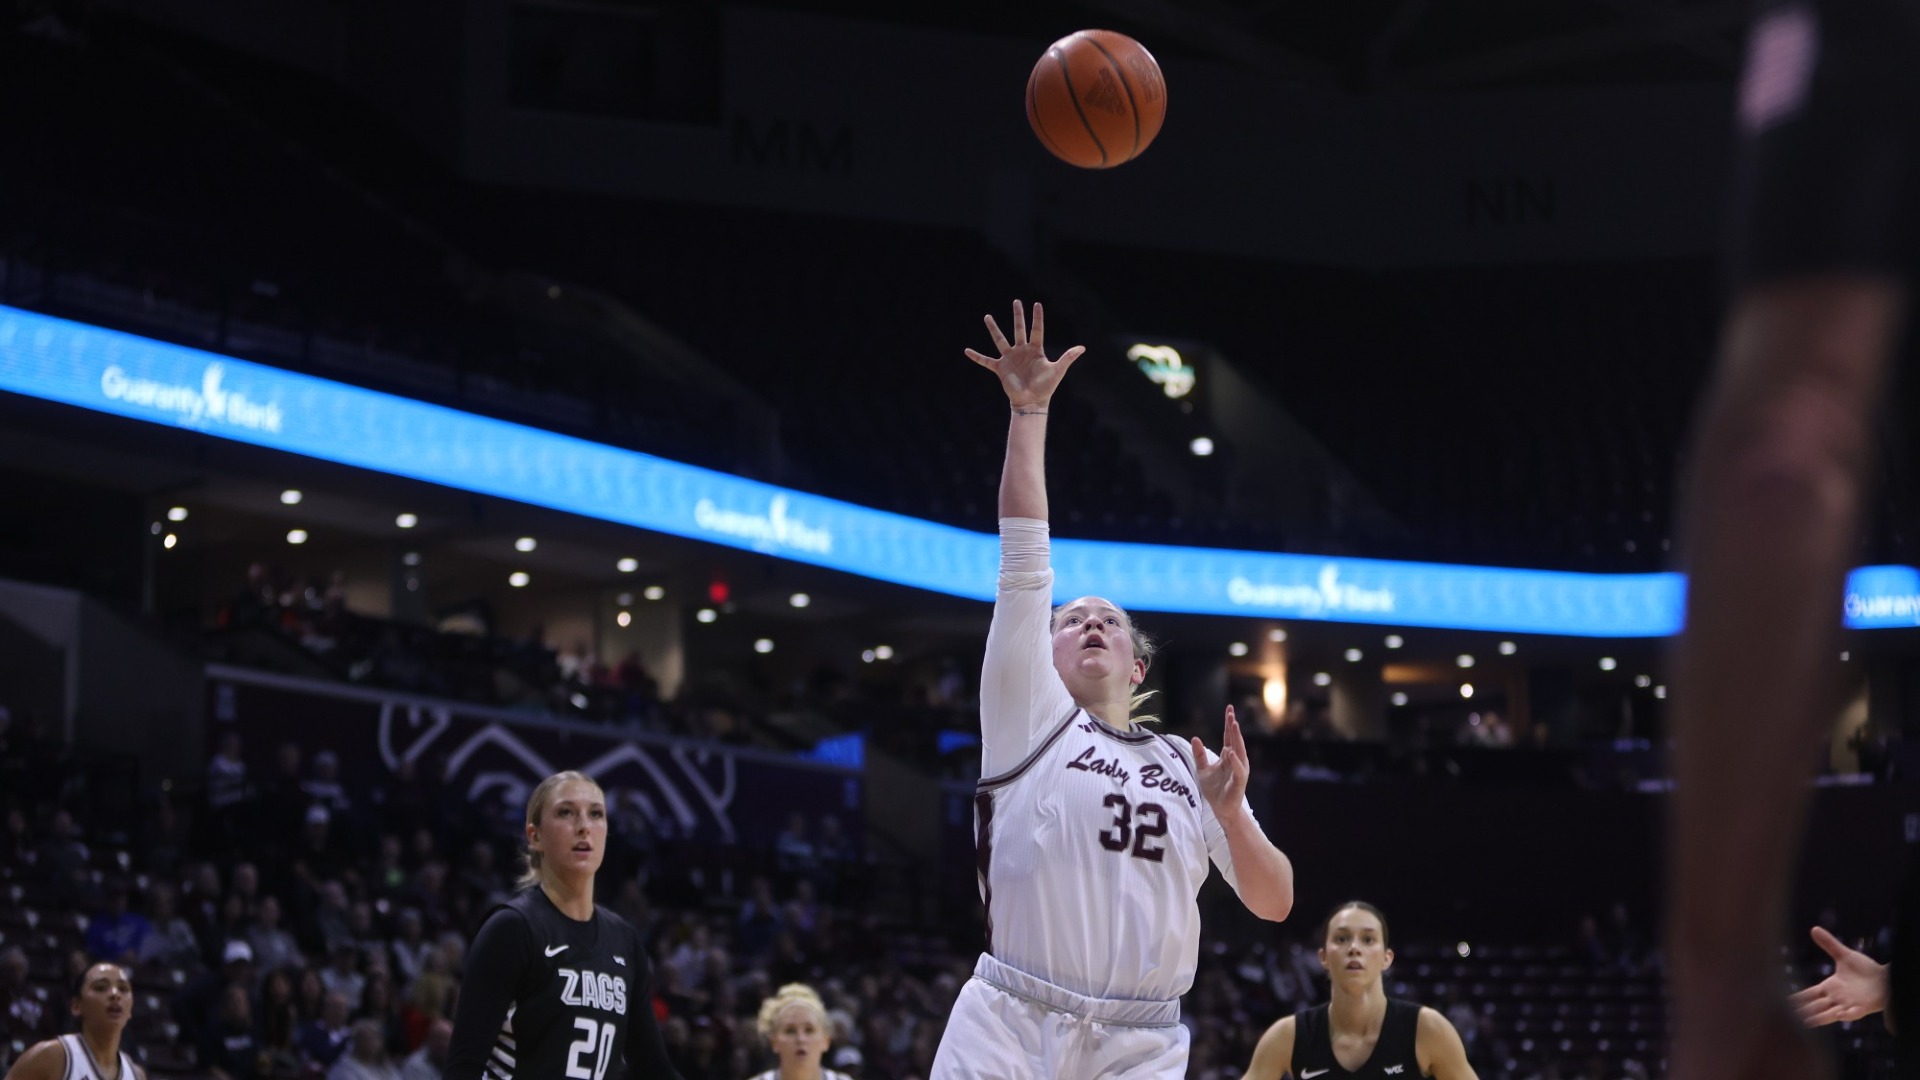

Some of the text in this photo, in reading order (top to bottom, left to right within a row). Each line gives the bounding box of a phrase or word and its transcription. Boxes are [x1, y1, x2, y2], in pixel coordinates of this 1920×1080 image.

[733, 118, 852, 176] MM
[1466, 176, 1553, 226] NN
[101, 364, 204, 422] Guaranty
[1066, 746, 1130, 787] Lady
[1099, 793, 1167, 863] 32
[558, 968, 627, 1015] ZAGS
[565, 1017, 616, 1080] 20
